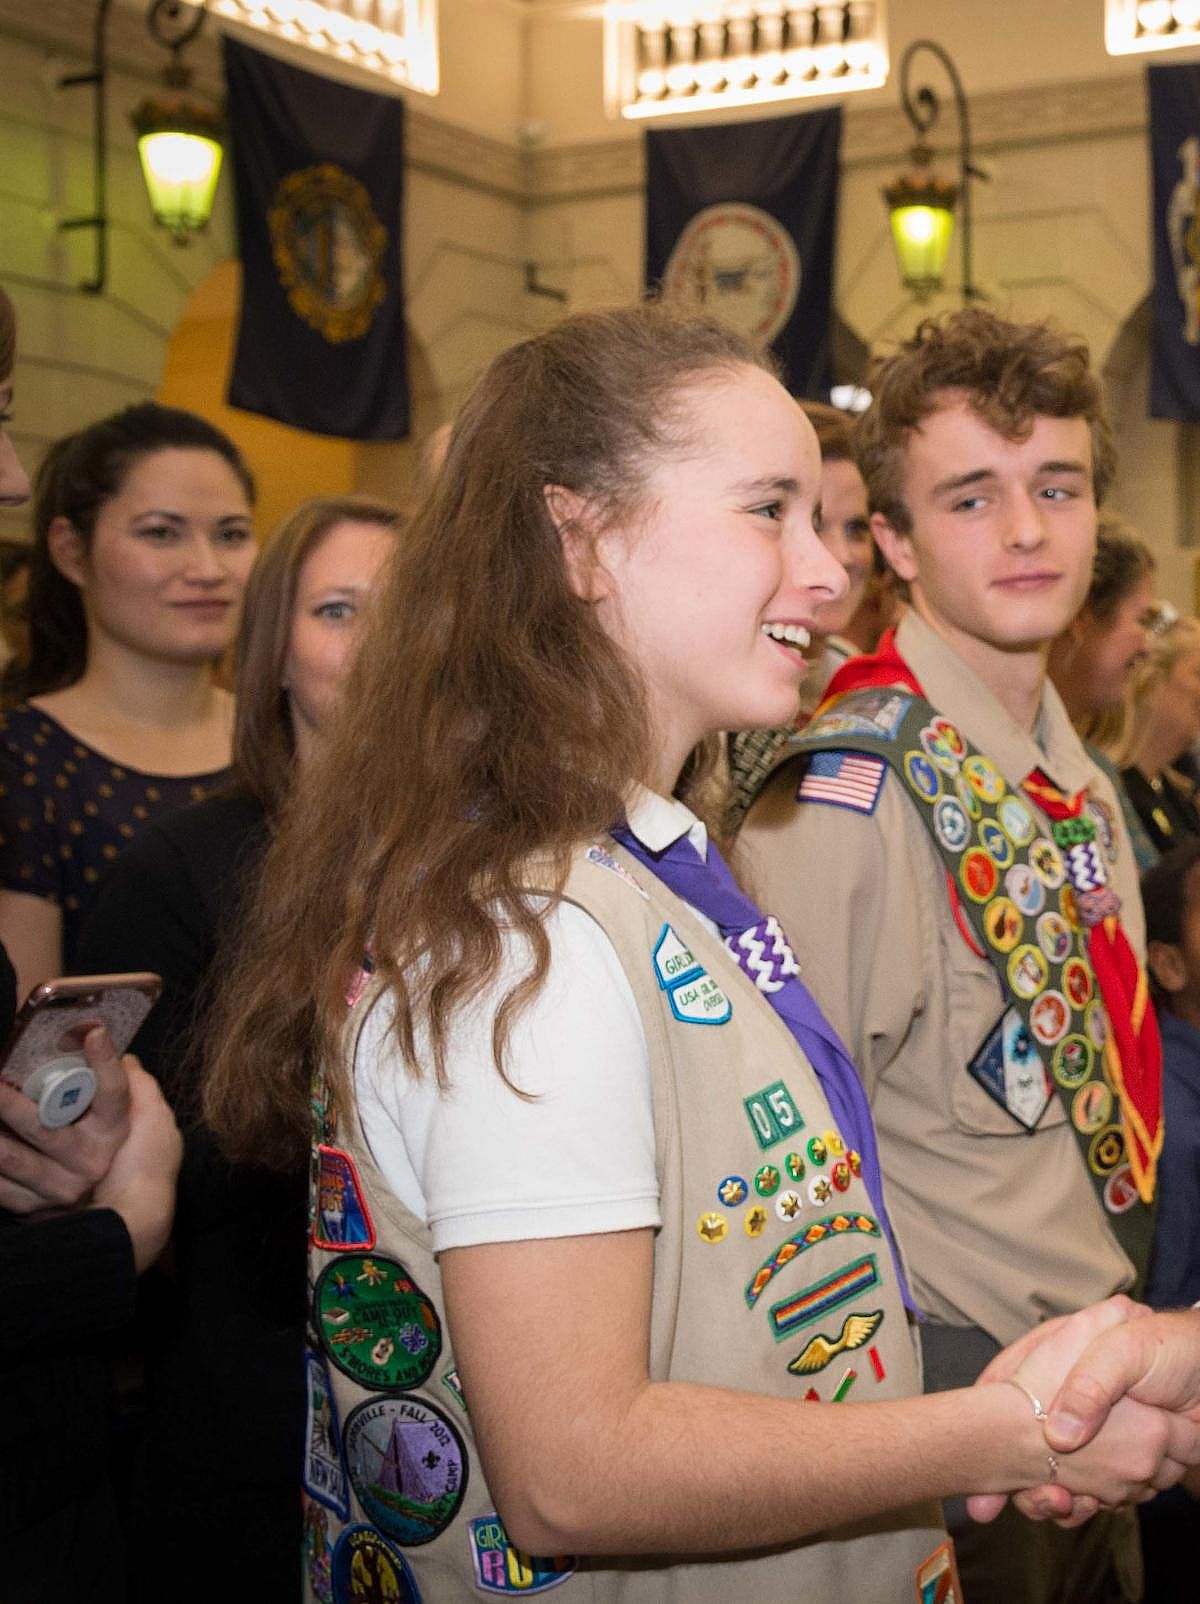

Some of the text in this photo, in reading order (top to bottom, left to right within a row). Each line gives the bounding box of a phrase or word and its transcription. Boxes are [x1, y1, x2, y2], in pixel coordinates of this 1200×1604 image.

[400, 1404, 427, 1424] FALL
[430, 1422, 451, 1448] 2012
[445, 1459, 458, 1492] CAMP
